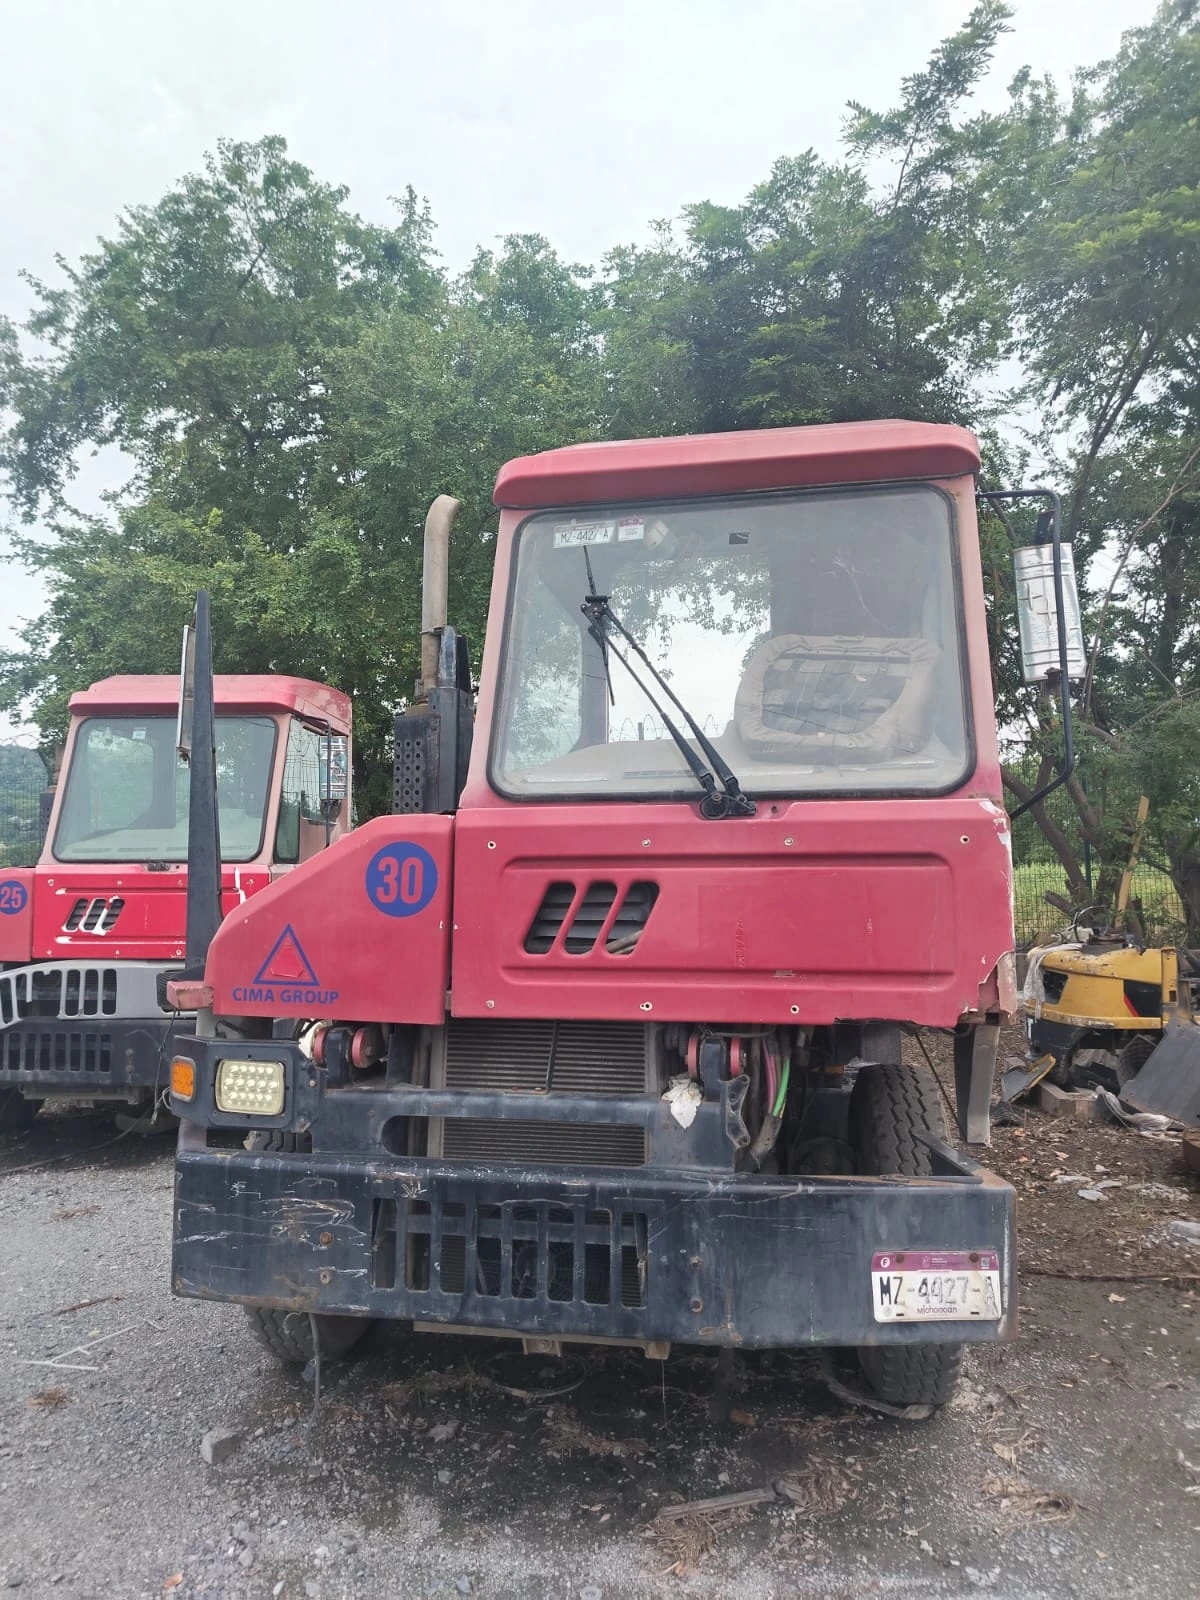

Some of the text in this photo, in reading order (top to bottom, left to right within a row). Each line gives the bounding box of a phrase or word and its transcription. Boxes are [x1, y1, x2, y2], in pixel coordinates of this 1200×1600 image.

[375, 856, 424, 904] 30
[0, 886, 22, 909] 25
[232, 987, 339, 1005] CIMA GROUP
